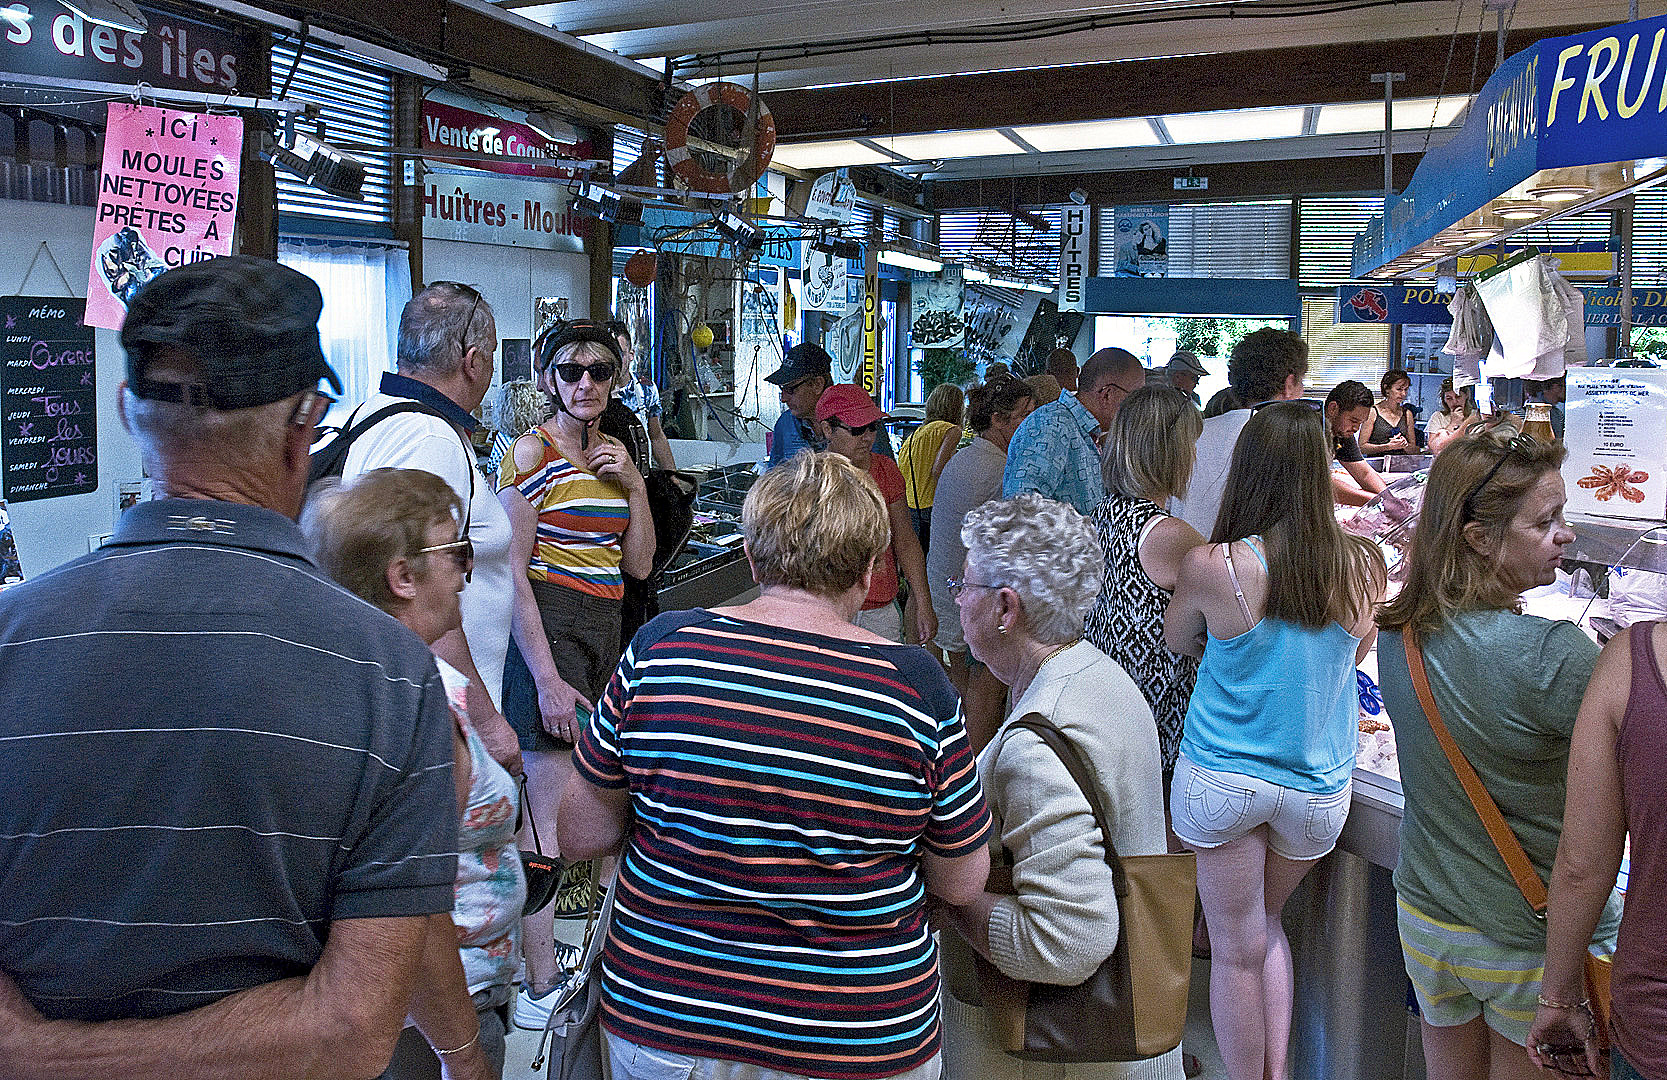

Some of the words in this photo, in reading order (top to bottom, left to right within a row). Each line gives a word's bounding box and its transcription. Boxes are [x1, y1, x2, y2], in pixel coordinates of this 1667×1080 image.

[51, 12, 143, 68] des
[159, 25, 238, 88] îles
[425, 115, 479, 151] Vente
[482, 127, 503, 155] de
[121, 149, 224, 181] MOULES
[102, 173, 235, 213] NETTOYÉES
[422, 183, 506, 228] Huîtres
[99, 201, 187, 234] PRÊTES
[1065, 209, 1084, 303] HUITRES
[1584, 290, 1639, 307] icols
[28, 305, 65, 319] MÉMO
[6, 335, 31, 343] LUNDI
[863, 274, 875, 393] MOULES
[6, 359, 32, 368] MARDI
[7, 386, 45, 395] MERCREDI
[7, 411, 31, 421] JEUDI
[31, 395, 81, 417] Tous
[8, 435, 46, 446] VENDREDI
[47, 417, 83, 443] les
[9, 461, 38, 472] SAMEDI
[10, 482, 48, 494] DIMANCHE
